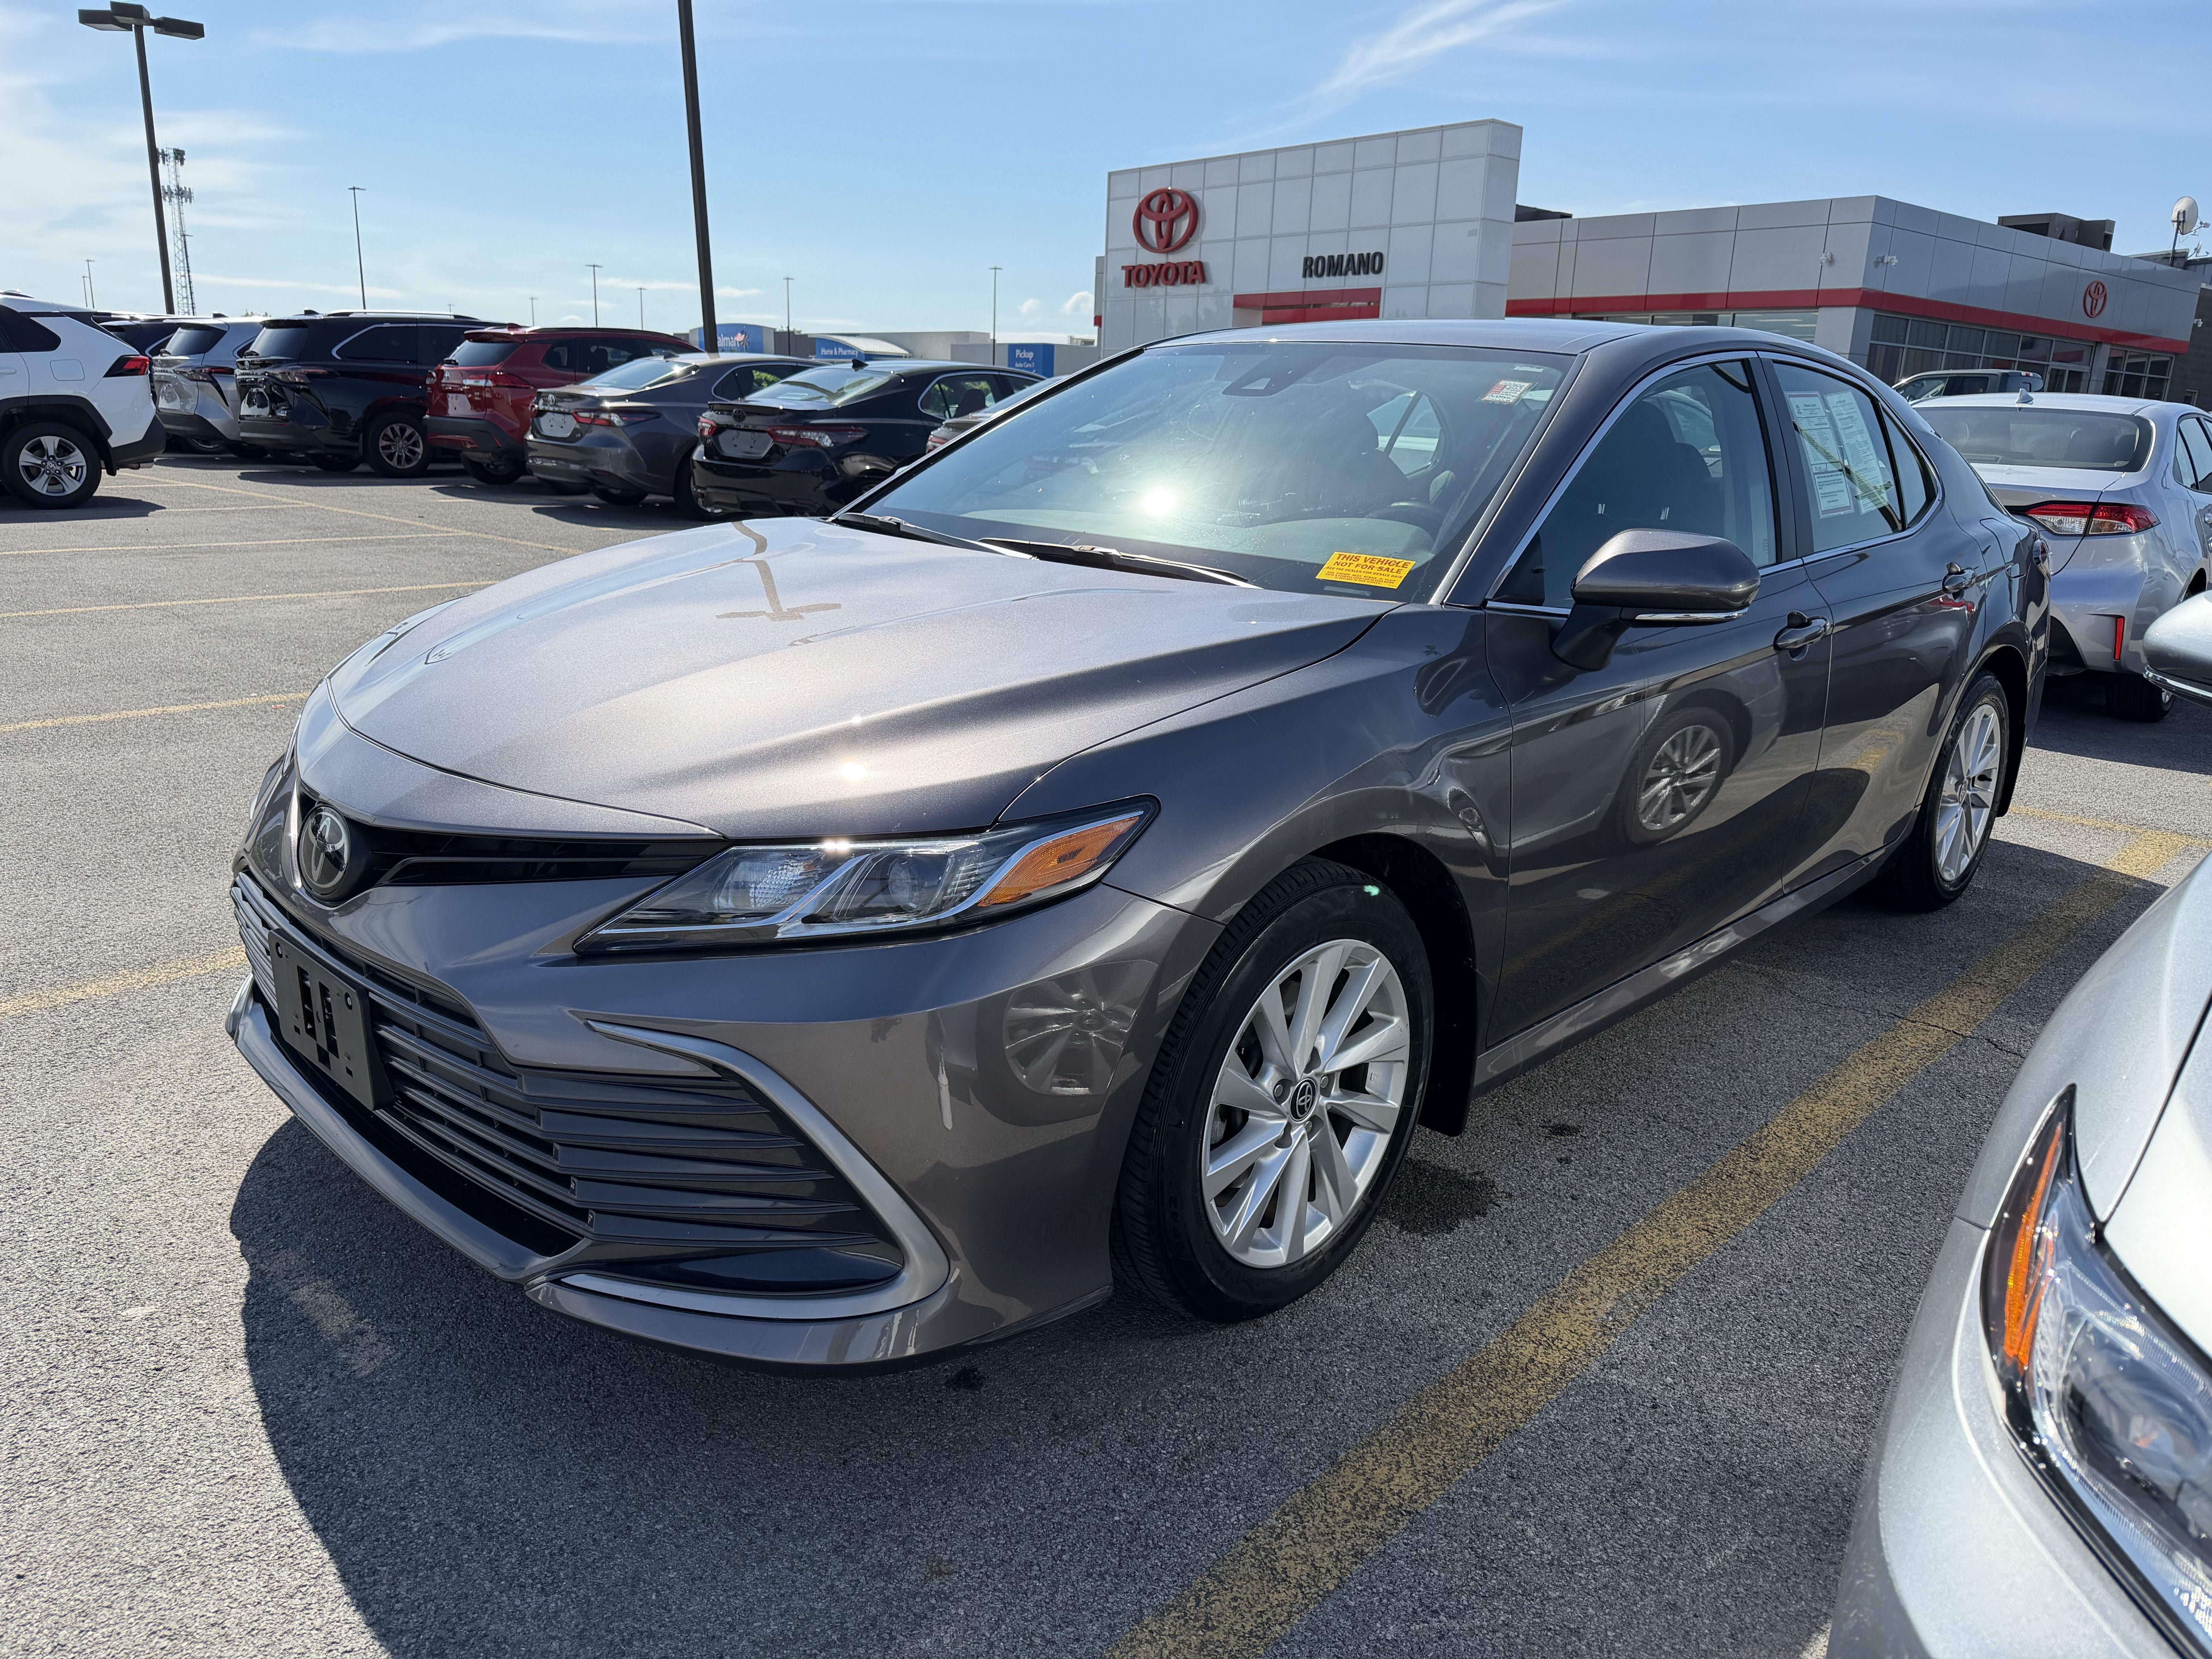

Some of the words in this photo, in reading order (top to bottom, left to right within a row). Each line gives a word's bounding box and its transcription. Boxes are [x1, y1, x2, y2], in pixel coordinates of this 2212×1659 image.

[1302, 252, 1383, 278] ROMANO
[1121, 261, 1206, 288] TOYOTA
[838, 347, 859, 357] Pharmacy
[1015, 349, 1034, 361] Pickup
[1364, 556, 1411, 568] VEHICLE
